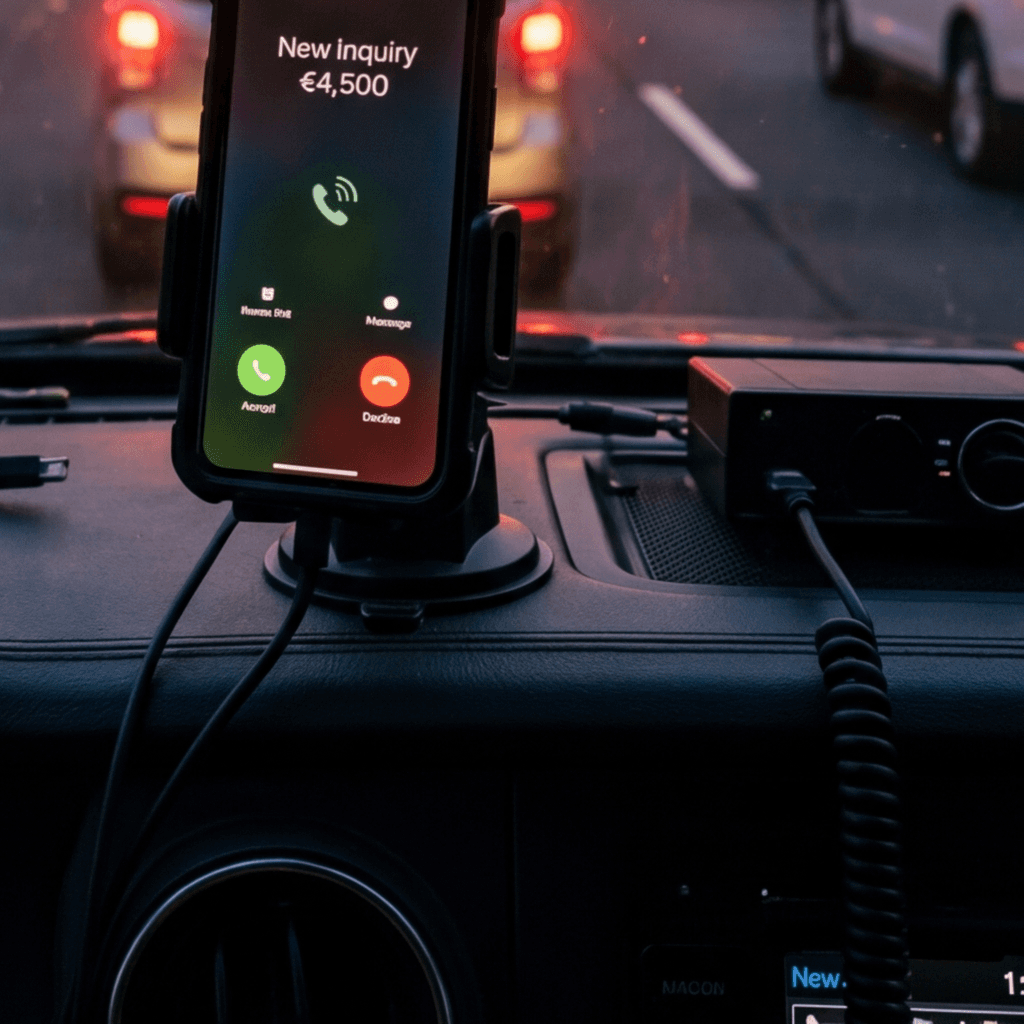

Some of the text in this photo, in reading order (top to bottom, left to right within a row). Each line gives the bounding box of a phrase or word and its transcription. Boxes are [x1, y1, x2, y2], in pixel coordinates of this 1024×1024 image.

[278, 36, 418, 69] New inquiry
[299, 71, 389, 97] €4,500
